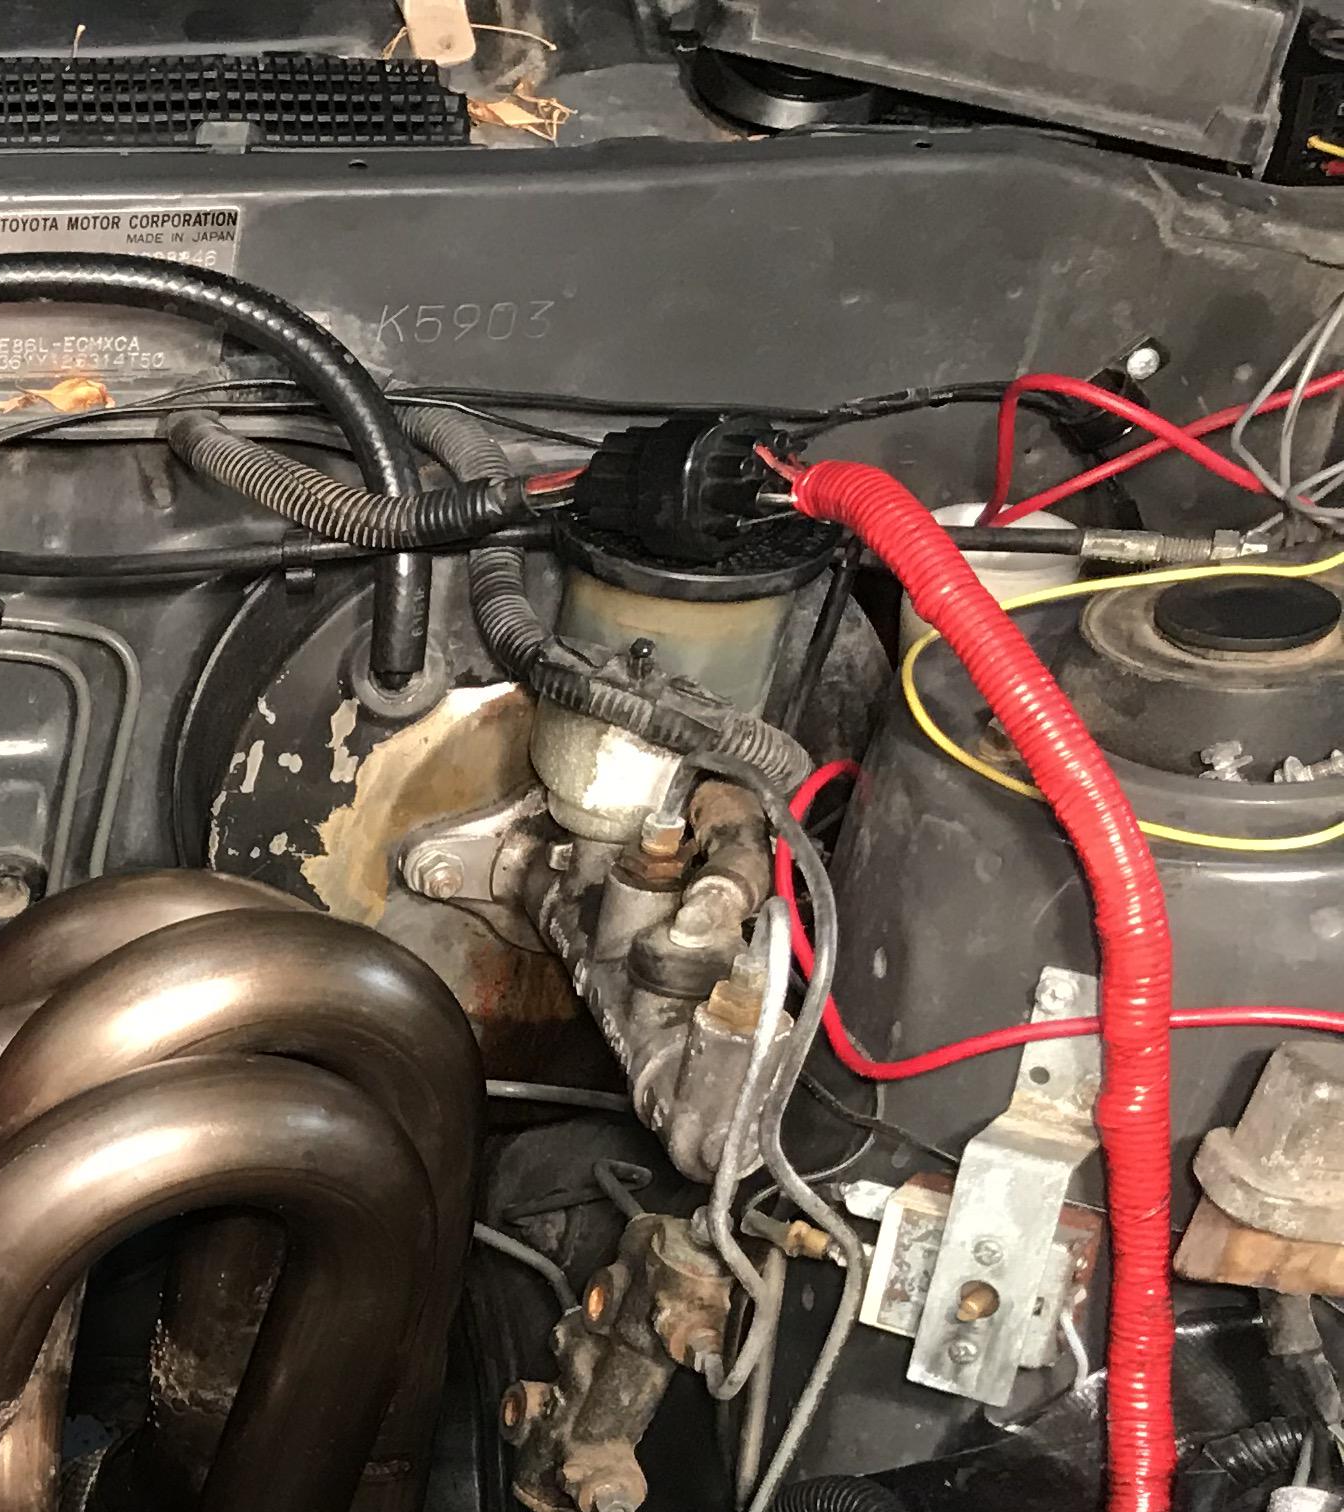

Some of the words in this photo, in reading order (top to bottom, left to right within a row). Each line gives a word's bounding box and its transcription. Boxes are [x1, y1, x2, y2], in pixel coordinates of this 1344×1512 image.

[0, 217, 59, 233] TOYOTA
[66, 215, 121, 231] MOTOR
[129, 210, 238, 230] CORPORATION
[126, 233, 164, 244] MADE
[171, 232, 185, 243] IN
[192, 231, 236, 243] JAPAN
[375, 300, 555, 343] K5903
